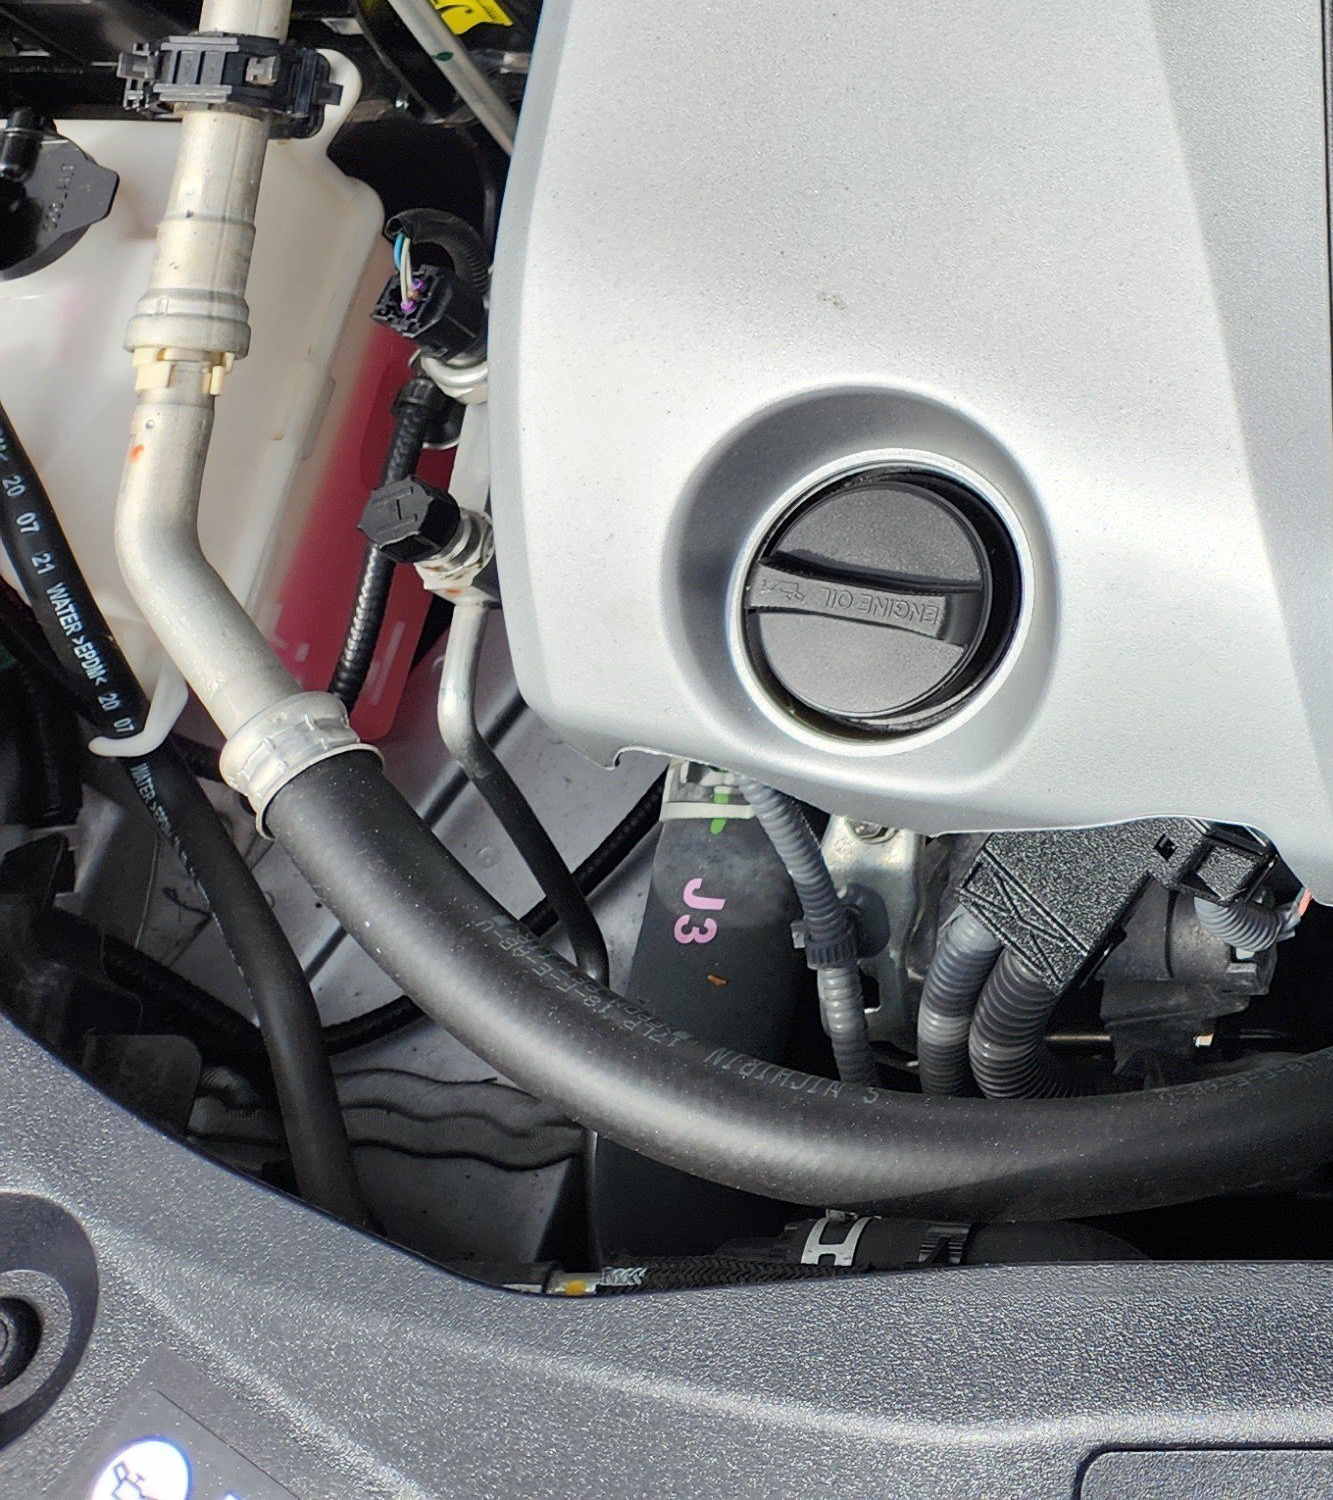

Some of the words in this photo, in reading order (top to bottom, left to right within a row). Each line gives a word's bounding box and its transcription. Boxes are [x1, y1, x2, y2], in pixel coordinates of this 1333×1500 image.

[2, 475, 25, 497] 20
[16, 512, 40, 534] 07
[31, 551, 55, 575] 21
[46, 582, 82, 636] WATER
[71, 636, 108, 686] >EPDM<
[98, 692, 120, 711] 20
[112, 716, 135, 733] 07
[821, 586, 854, 608] OIL
[858, 593, 939, 624] ENGINE
[129, 760, 154, 803] WATER
[674, 877, 727, 944] J3
